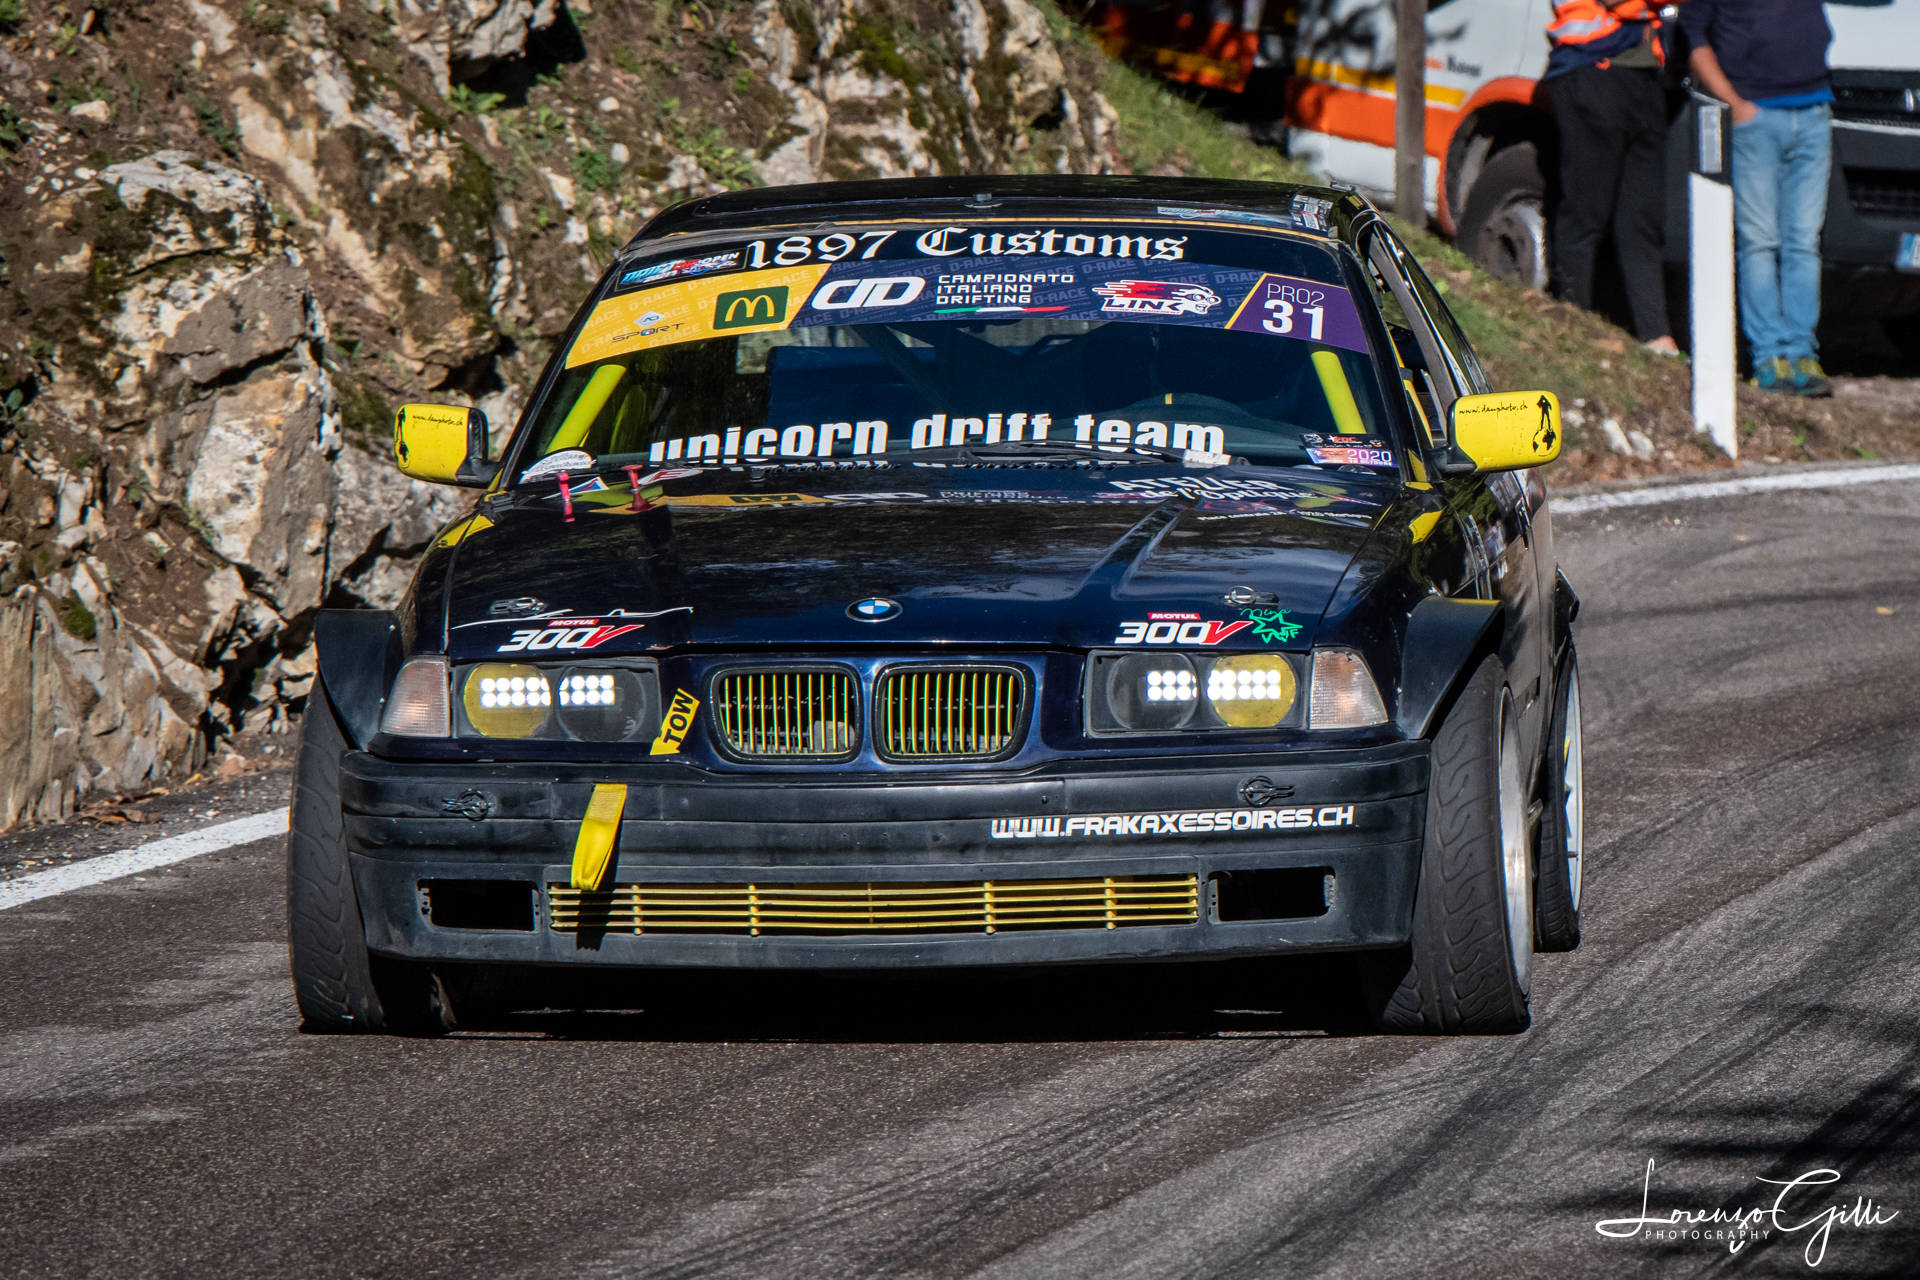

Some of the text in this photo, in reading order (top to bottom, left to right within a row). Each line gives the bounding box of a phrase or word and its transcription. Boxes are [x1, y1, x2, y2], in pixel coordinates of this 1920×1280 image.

[746, 227, 1188, 268] 1897 Customs
[1082, 259, 1136, 273] D-RACE
[938, 274, 1074, 283] CAMPIONATO
[936, 284, 1033, 294] ITALIANO
[1034, 288, 1087, 305] D-RACE
[1267, 283, 1325, 307] PRO2
[936, 294, 1032, 305] DRIFTING
[1105, 298, 1184, 311] LINK
[1262, 298, 1325, 341] 31
[612, 323, 686, 344] SPORT
[648, 419, 889, 467] unicorn
[911, 412, 1053, 466] drift
[1073, 413, 1231, 466] team
[1347, 448, 1393, 463] 2020
[1108, 476, 1295, 491] ATELIER
[547, 619, 596, 627] MOTUL
[1114, 620, 1255, 645] 300V
[496, 624, 646, 653] 300V
[663, 691, 694, 744] TOW
[990, 805, 1355, 839] WWW.FRAKAXESSOIRES.CH
